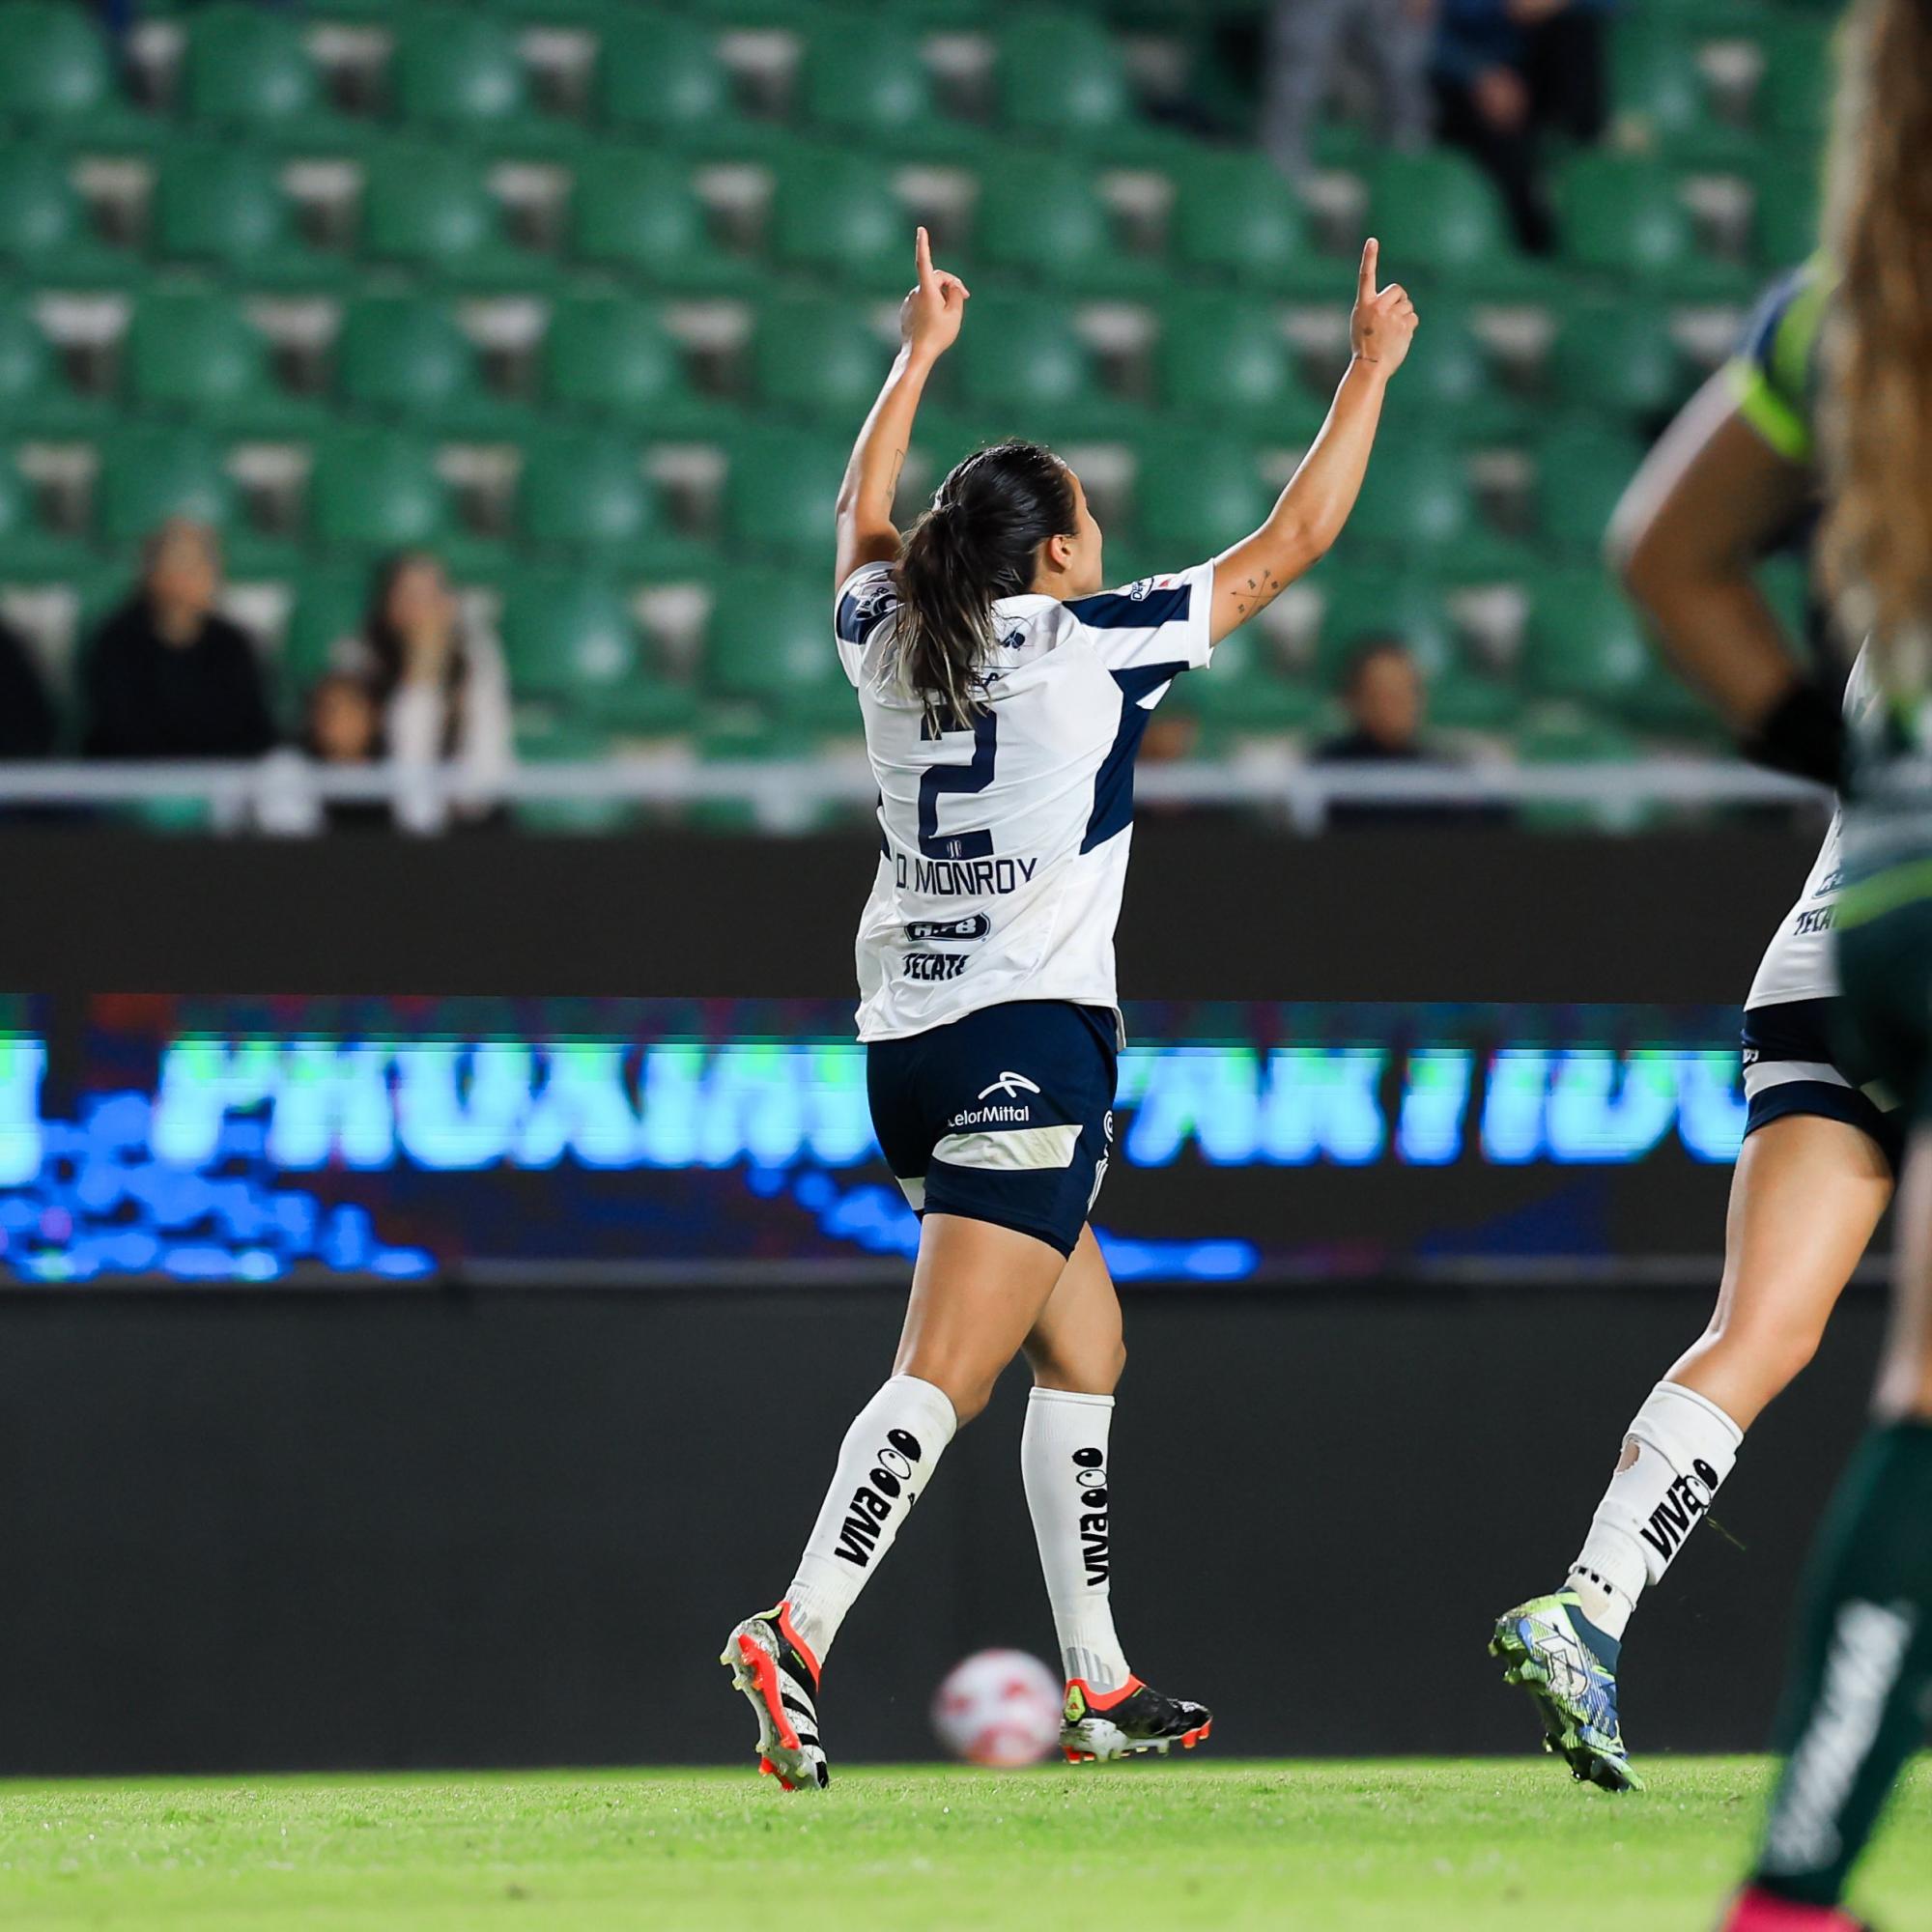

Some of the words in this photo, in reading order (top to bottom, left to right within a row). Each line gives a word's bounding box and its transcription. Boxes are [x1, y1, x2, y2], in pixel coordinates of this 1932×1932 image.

[918, 702, 998, 861] 2
[896, 853, 910, 890] D.
[915, 858, 1037, 895] MONROY
